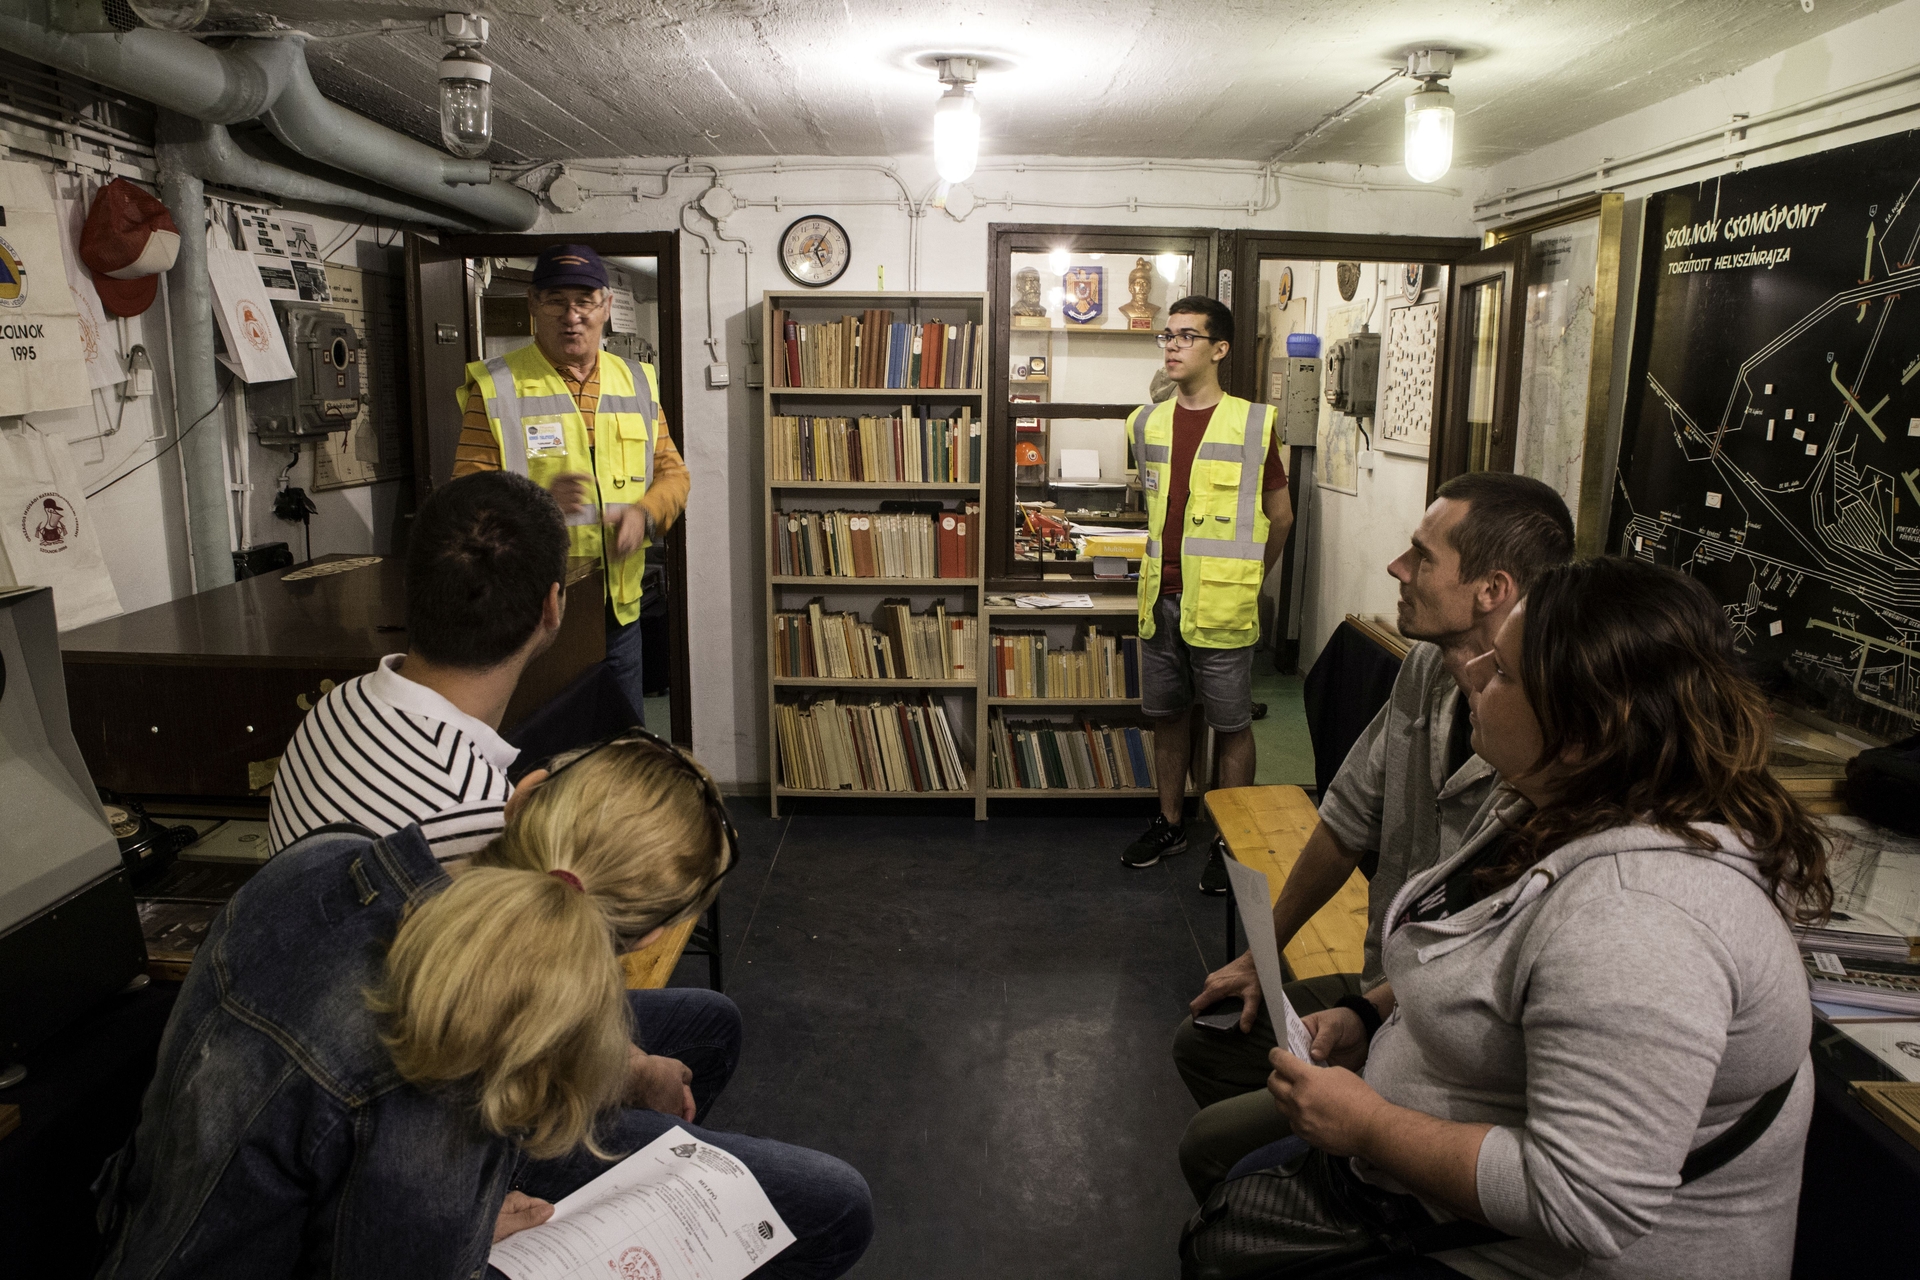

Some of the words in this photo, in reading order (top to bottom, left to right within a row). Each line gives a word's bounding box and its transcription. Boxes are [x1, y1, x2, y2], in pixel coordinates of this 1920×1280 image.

[1664, 218, 1723, 252] SZOLNOK
[1724, 202, 1828, 243] CSOMÓPONT
[1668, 252, 1712, 275] TORZÍTOTT
[1714, 245, 1792, 270] HELYSZÍNRAJZA
[10, 345, 37, 361] 1995
[1103, 545, 1135, 554] Multilaser
[698, 1179, 718, 1201] BELÉPŐ
[746, 1247, 759, 1264] 23.
